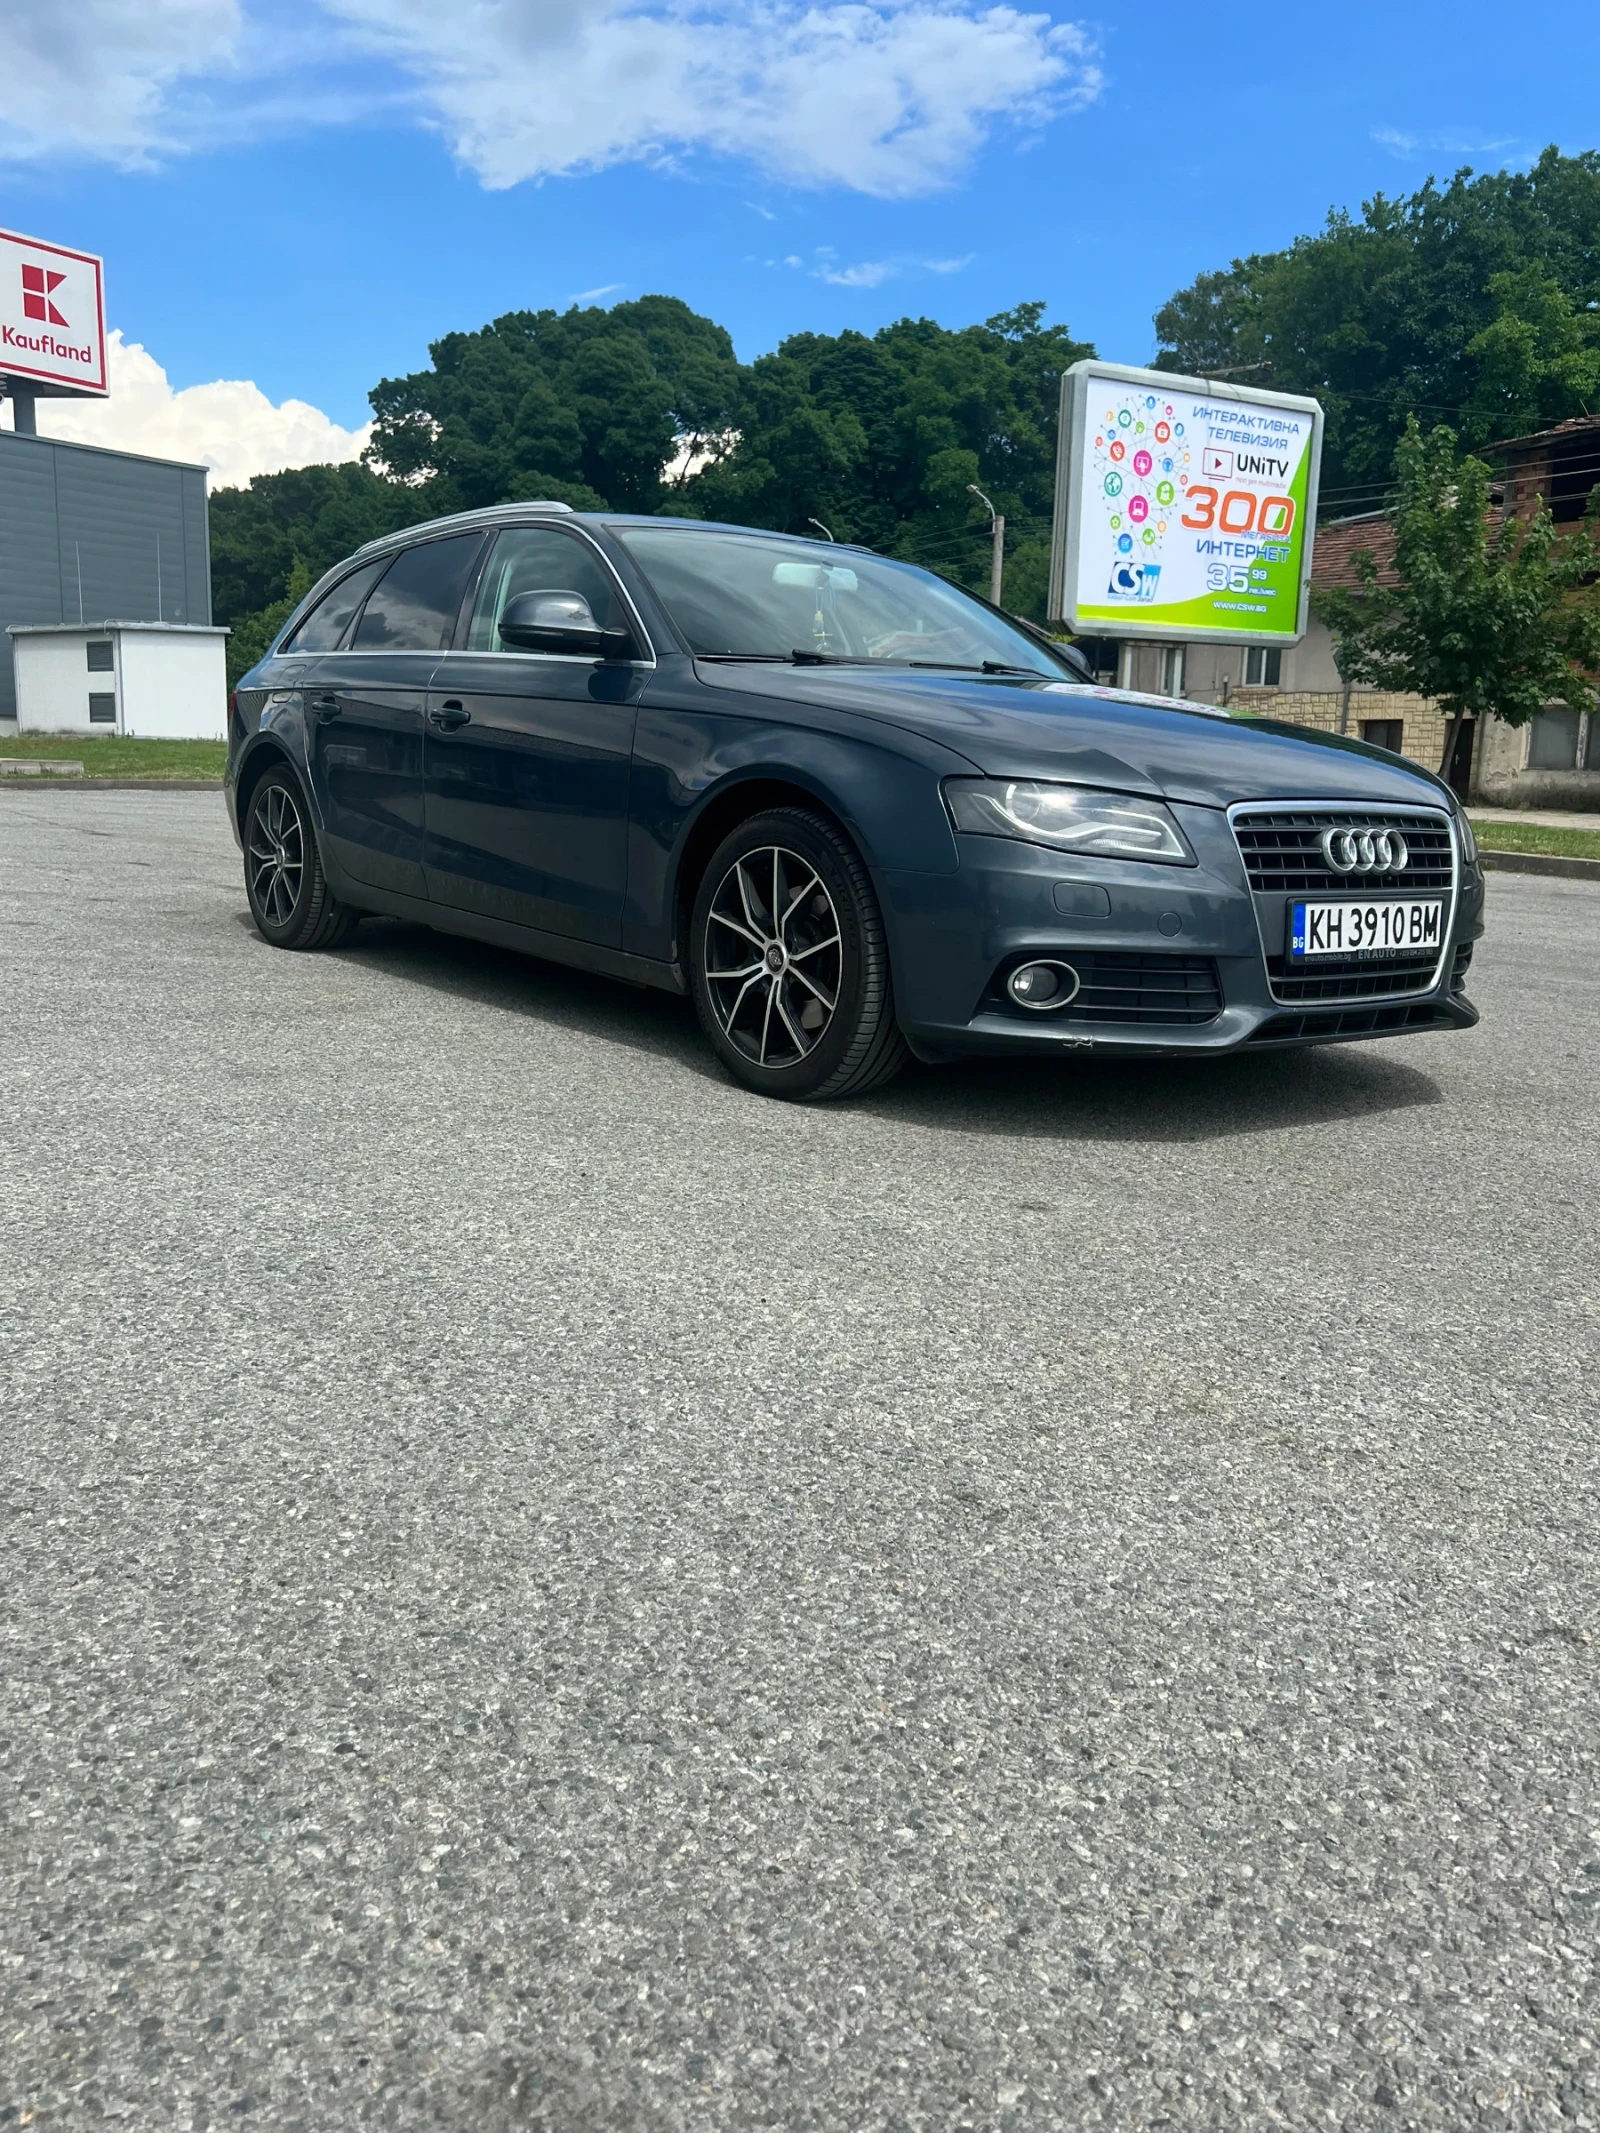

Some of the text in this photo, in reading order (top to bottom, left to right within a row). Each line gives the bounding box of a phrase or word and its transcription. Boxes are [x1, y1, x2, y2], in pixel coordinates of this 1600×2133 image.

[2, 325, 92, 363] Kaufland
[1193, 406, 1299, 434] ИНТЕРАКТИВНА
[1209, 427, 1288, 449] ТЕЛЕВИЗИЯ
[1181, 485, 1295, 536] 300
[1197, 538, 1290, 562] ИНТЕРНЕТ
[1207, 563, 1267, 594] 35 99
[1310, 905, 1439, 950] KH 3910 BM
[1292, 936, 1304, 949] BG
[1358, 950, 1370, 960] EN
[1373, 948, 1396, 959] AUTO
